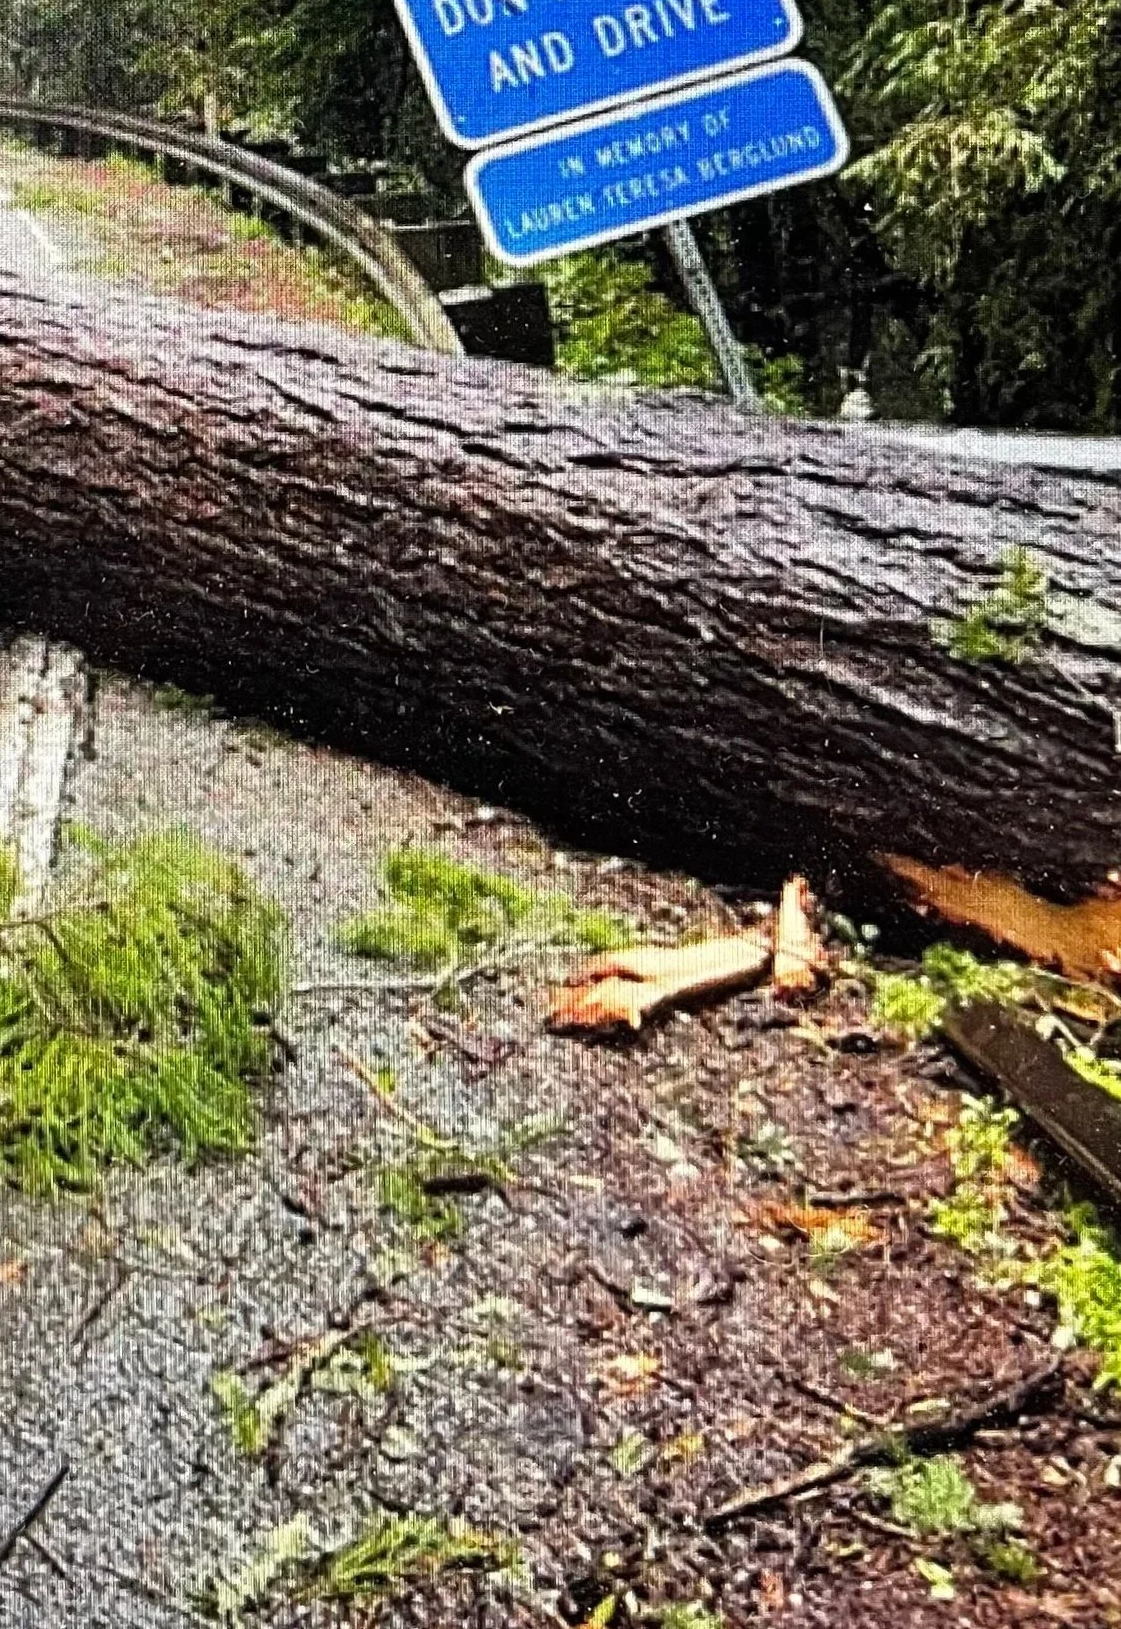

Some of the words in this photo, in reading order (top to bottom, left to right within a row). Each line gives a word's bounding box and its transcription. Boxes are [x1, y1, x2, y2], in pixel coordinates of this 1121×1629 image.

[489, 31, 576, 94] AND
[558, 153, 585, 179] IN
[595, 119, 690, 168] MEMORY
[701, 104, 731, 137] OF
[504, 192, 596, 239] LAUREN
[603, 165, 690, 208] TERESA
[696, 125, 821, 182] BERGLUND
